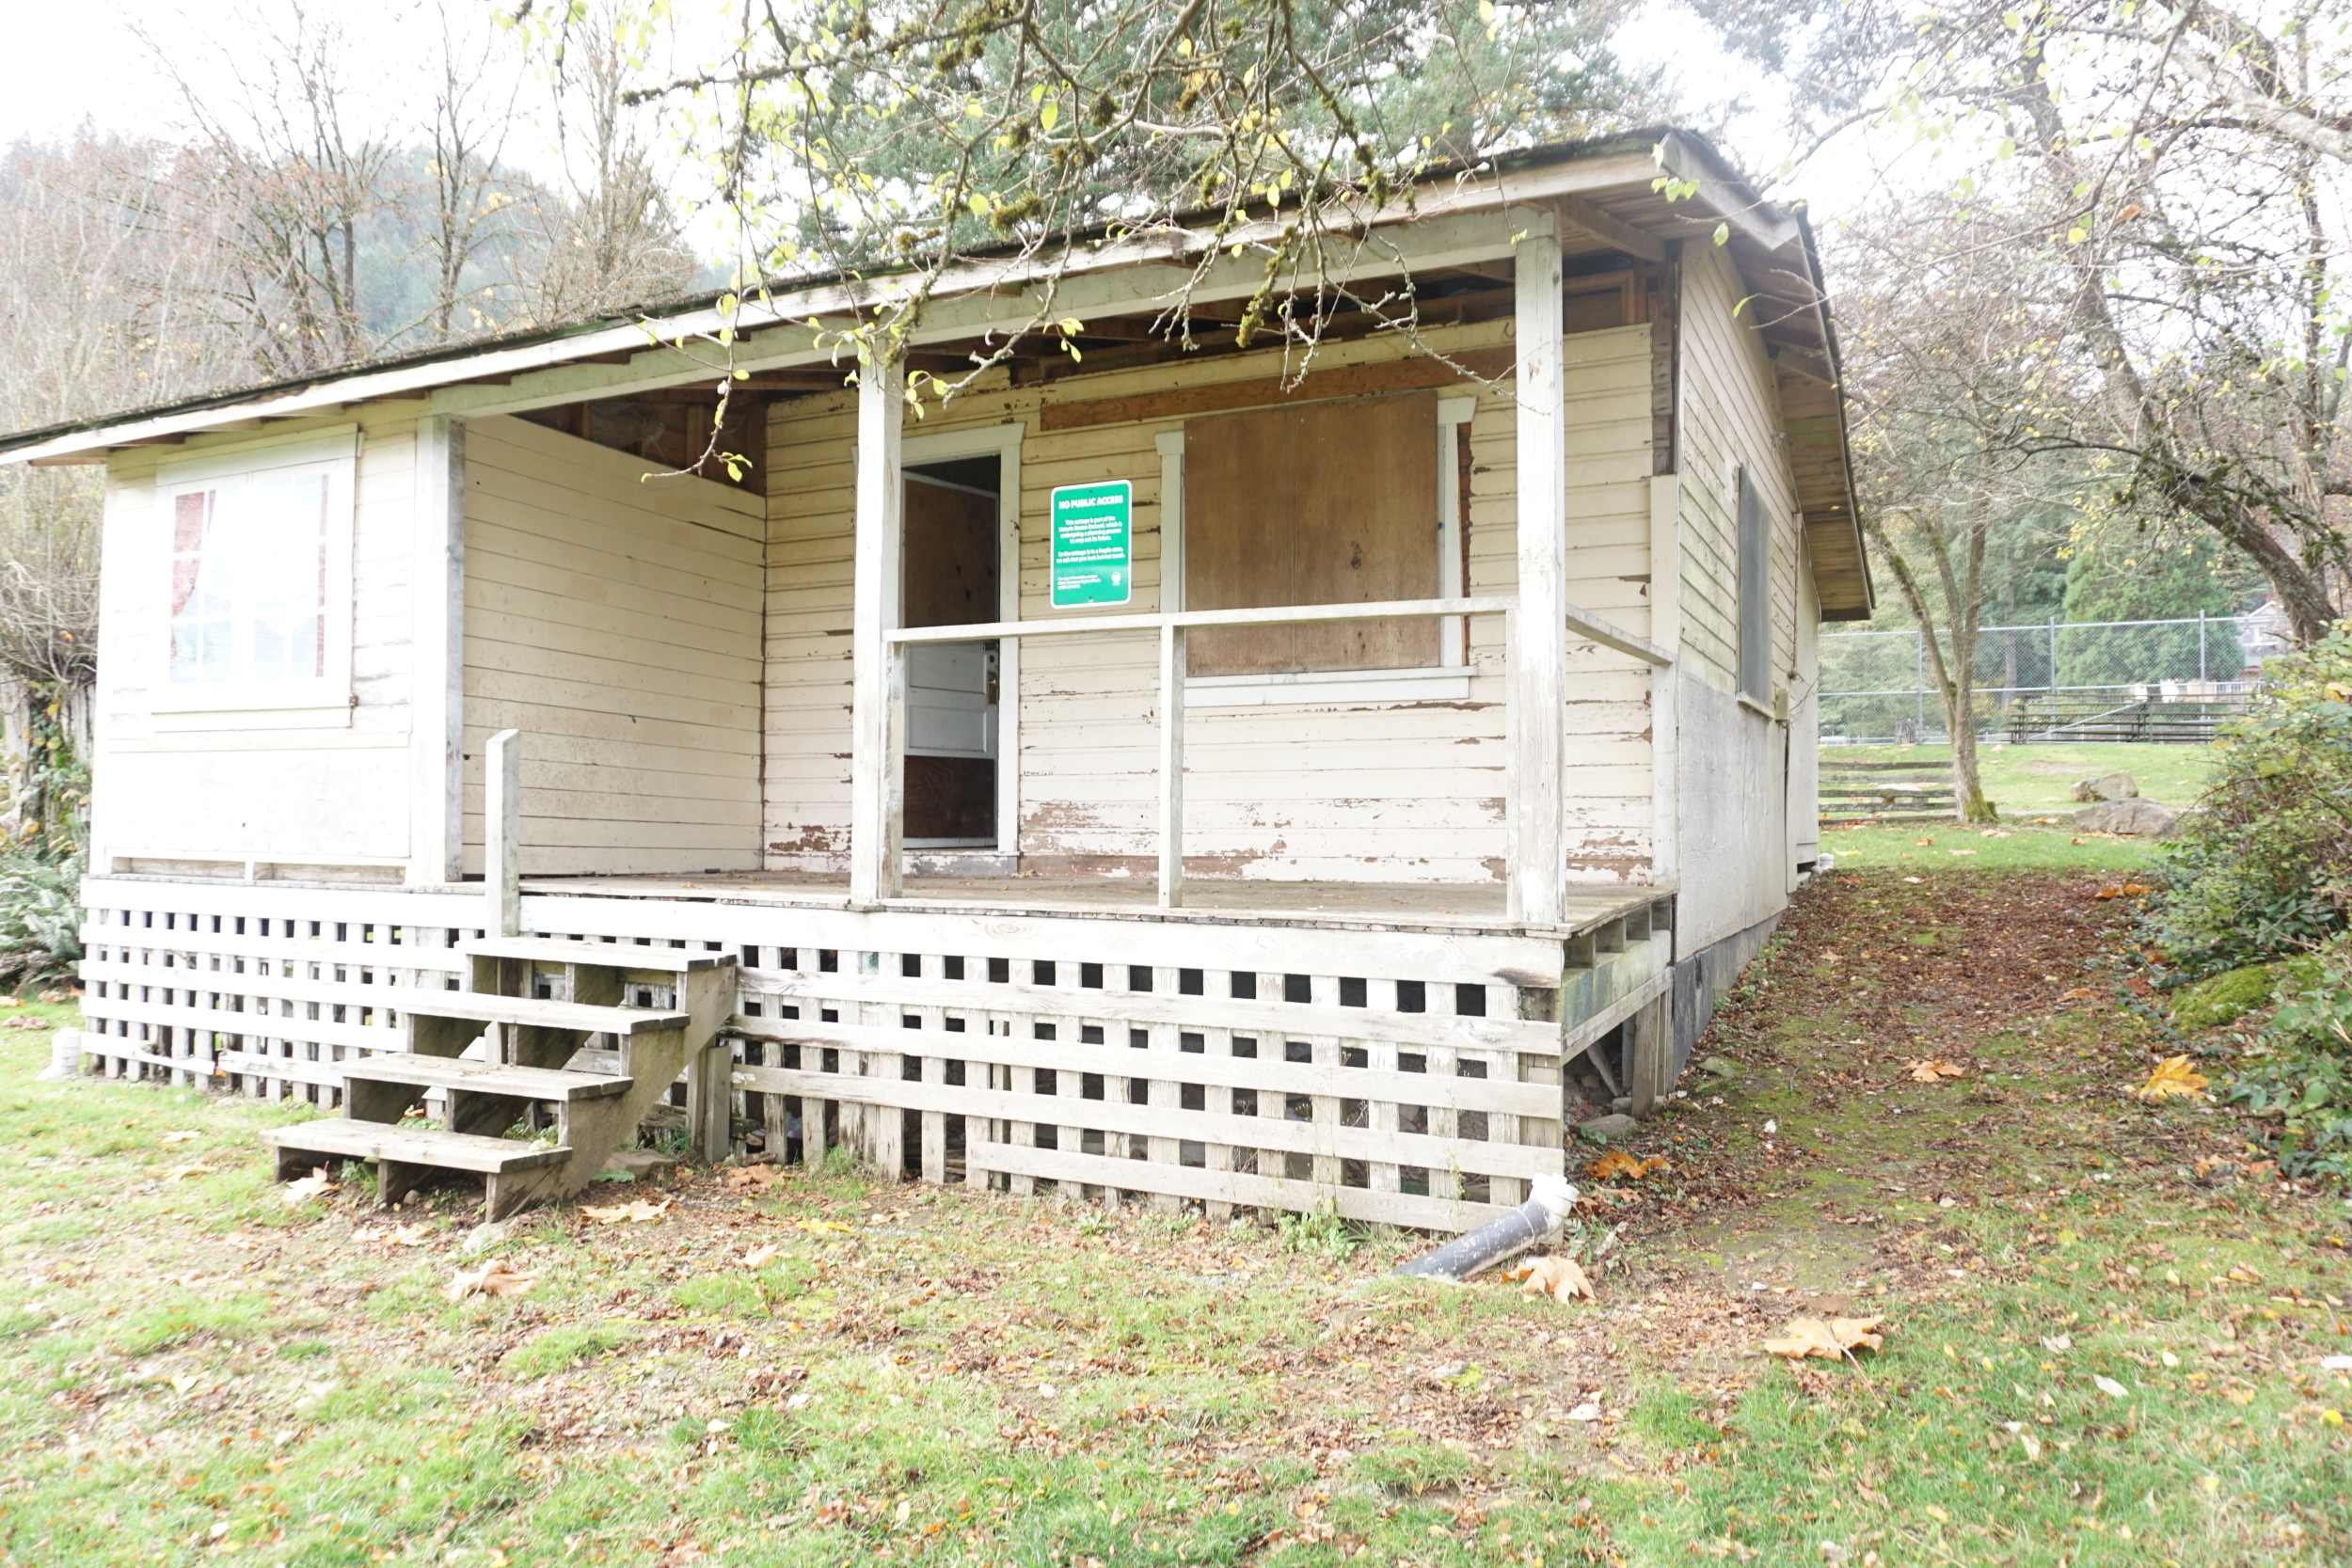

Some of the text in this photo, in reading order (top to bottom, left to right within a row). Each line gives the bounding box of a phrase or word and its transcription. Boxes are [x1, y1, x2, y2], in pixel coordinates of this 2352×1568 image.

[1058, 495, 1123, 510] NO PUBLIC ACCESS
